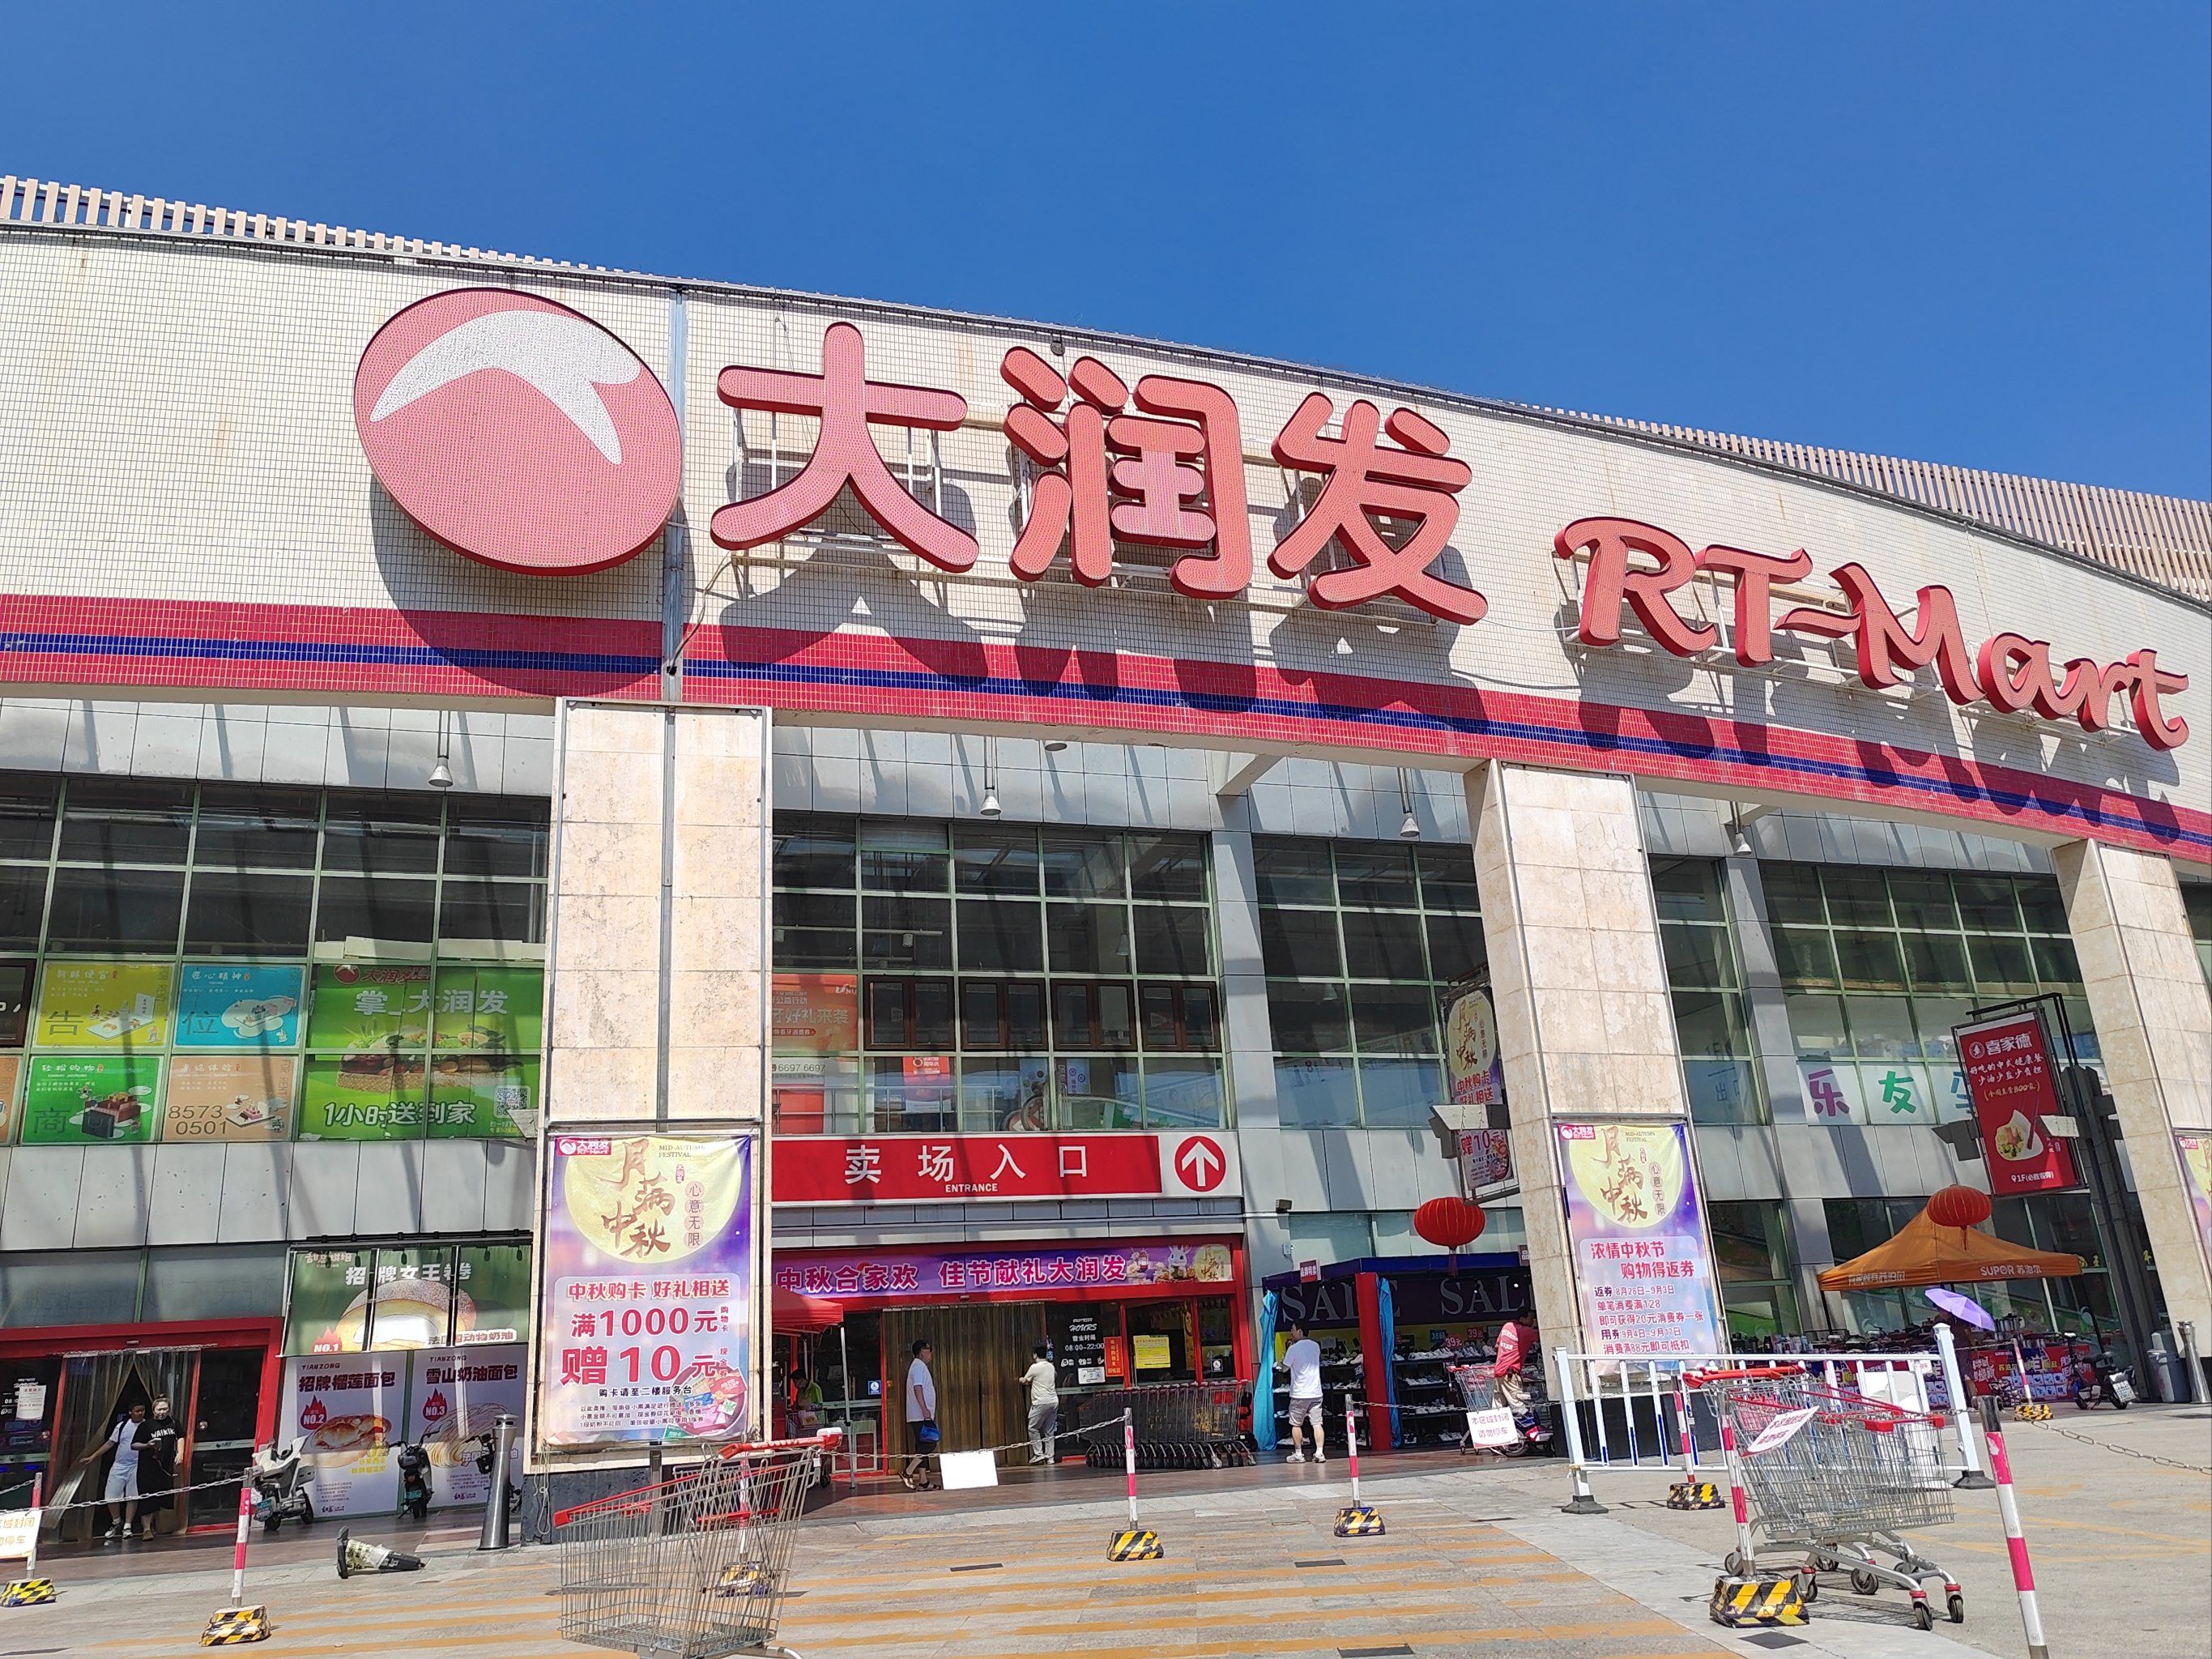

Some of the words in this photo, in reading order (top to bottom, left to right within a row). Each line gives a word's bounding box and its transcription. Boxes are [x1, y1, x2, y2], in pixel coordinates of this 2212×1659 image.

[710, 322, 1489, 625] 大润发
[1554, 516, 2190, 752] RT-Mart
[45, 1010, 83, 1036] 告
[182, 1010, 219, 1036] 位
[1985, 1033, 2032, 1055] 喜家德
[778, 1064, 801, 1072] 6697
[803, 1064, 825, 1072] 6697
[1969, 1053, 2044, 1075] 好吃的中式健康餐
[1458, 1070, 1491, 1092] 中秋购卡
[1979, 1066, 2043, 1086] 少油少盐少负担
[1460, 1087, 1494, 1104] 好礼相送
[168, 1105, 223, 1120] 8573
[325, 1100, 475, 1128] 1小时送到家
[175, 1120, 228, 1135] 0501
[845, 1144, 1087, 1184] 卖场入口
[1590, 1126, 1647, 1223] 月满中秋
[596, 1137, 676, 1258] 月满中秋
[945, 1183, 998, 1192] ENTRANCE
[1651, 1162, 1666, 1215] 心意无限
[687, 1183, 702, 1247] 心意无限
[1591, 1241, 1665, 1260] 浓情中秋节
[775, 1260, 919, 1294] 中秋合家欢
[940, 1254, 1127, 1288] 佳节献礼大润发
[1621, 1260, 1695, 1280] 购物得返券
[1980, 1265, 2015, 1277] SUPOR
[2018, 1263, 2042, 1275] 苏泊尔
[568, 1282, 647, 1301] 中秋购卡
[651, 1279, 731, 1298] 好礼相送
[1440, 1276, 1535, 1316] SAL
[1597, 1299, 1661, 1311] 单笔消费满128
[570, 1307, 718, 1338] 满1000元
[720, 1305, 729, 1333] 购物卡
[1599, 1311, 1704, 1327] 即可获得20元消费券一张
[313, 1343, 339, 1353] NO.1
[1072, 1333, 1096, 1342] 营业时间
[1446, 1337, 1463, 1348] 39元
[1603, 1339, 1690, 1354] 消费满88元即可抵扣
[426, 1364, 518, 1385] 雪山奶油面包
[560, 1345, 718, 1387] 赠10元
[299, 1371, 396, 1392] 招牌榴莲面包
[599, 1384, 693, 1398] 购卡请至二楼服务台
[303, 1414, 325, 1425] NO.2
[425, 1406, 445, 1416] NO.3
[1478, 1427, 1508, 1438] 请勿停车
[0, 1516, 35, 1530] 域封闭
